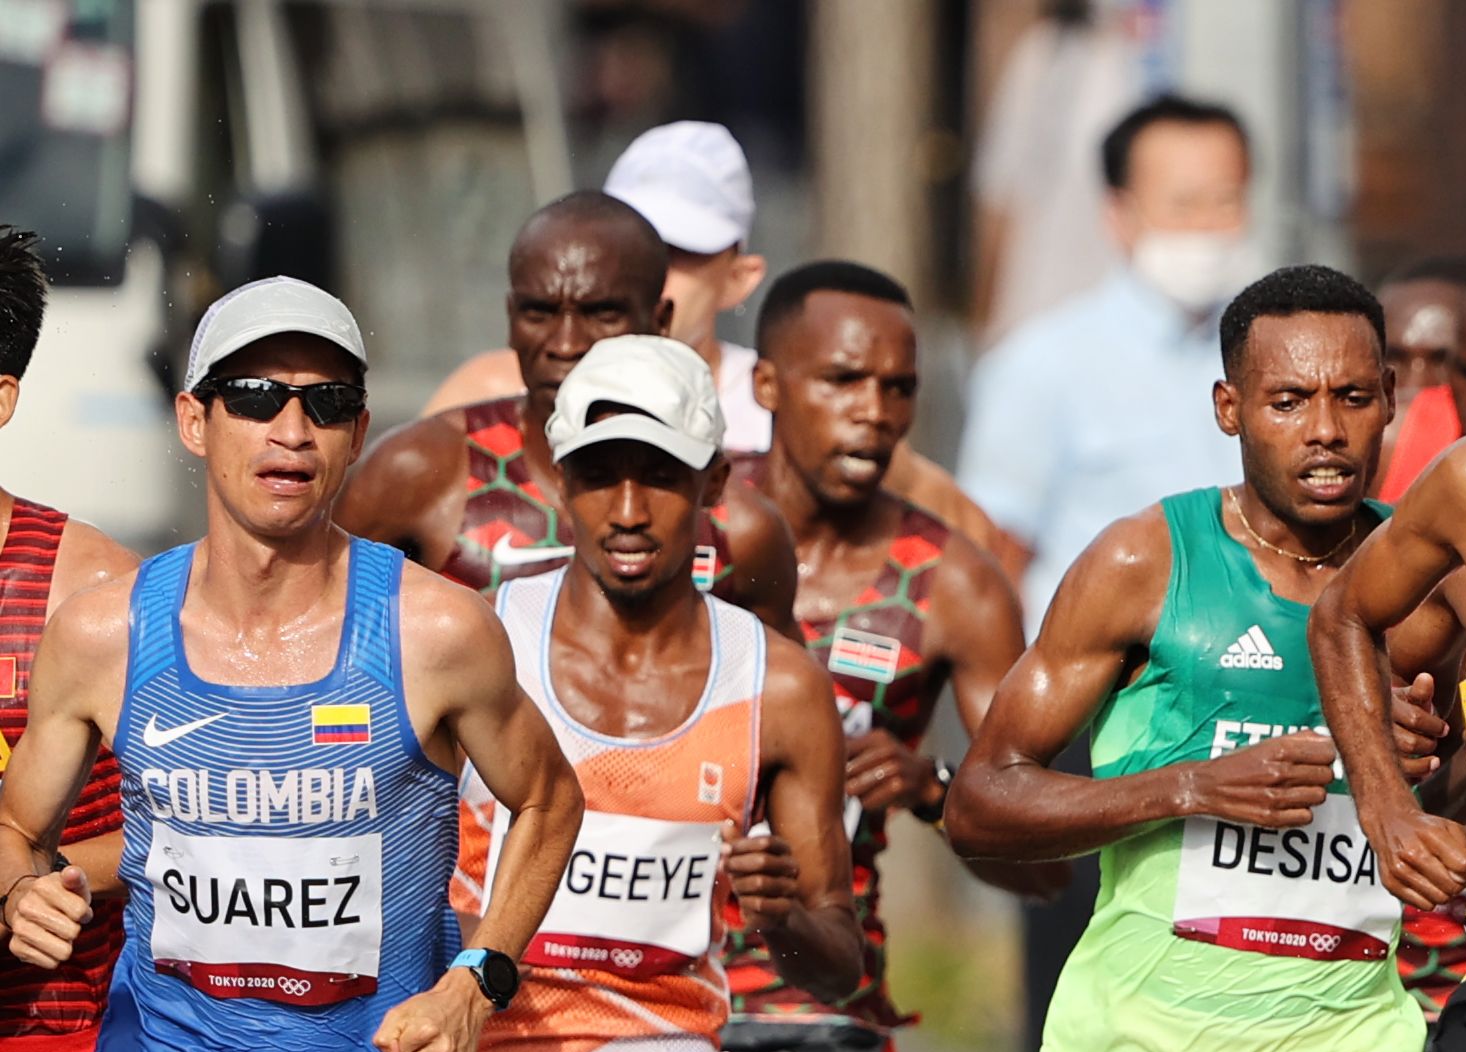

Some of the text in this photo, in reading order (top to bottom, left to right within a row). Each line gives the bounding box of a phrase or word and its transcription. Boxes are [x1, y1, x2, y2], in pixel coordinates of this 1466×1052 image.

[1219, 653, 1283, 671] adidas
[140, 766, 379, 825] COLOMBIA
[1211, 820, 1376, 886] DESISA
[565, 849, 710, 901] GEEYE
[162, 868, 361, 929] SUAREZ
[543, 942, 609, 961] TOKYO 2020
[1241, 927, 1307, 946] TOKYO 2020
[208, 975, 276, 989] TOKYO 2020
